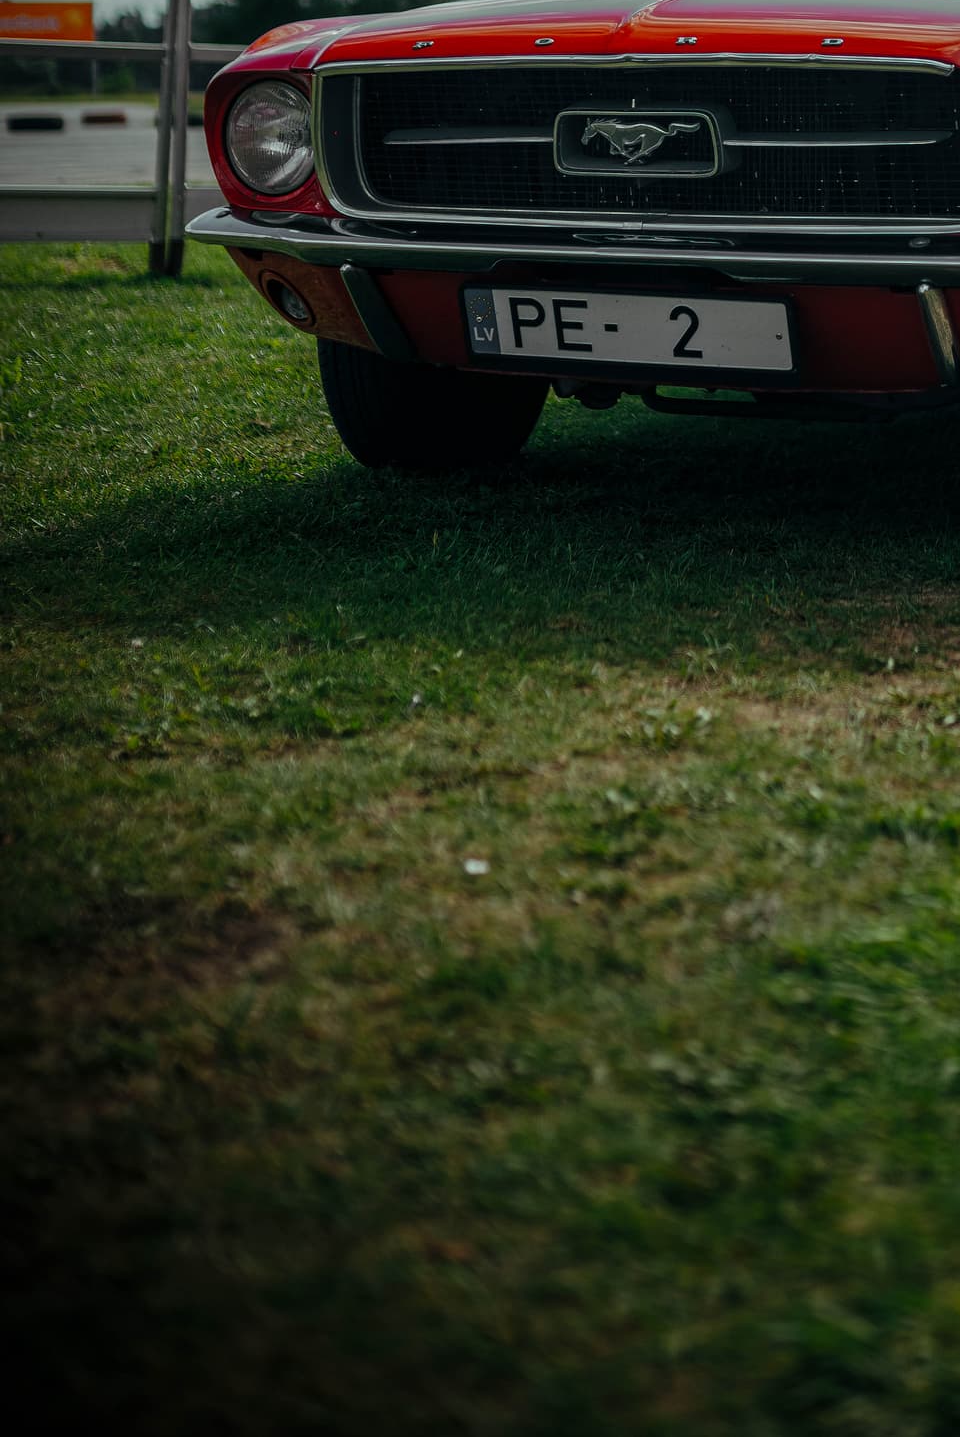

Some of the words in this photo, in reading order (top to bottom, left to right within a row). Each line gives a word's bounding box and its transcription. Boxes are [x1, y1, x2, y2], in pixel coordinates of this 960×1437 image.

[412, 36, 844, 51] FORD
[473, 326, 495, 342] LV
[668, 305, 704, 359] 2
